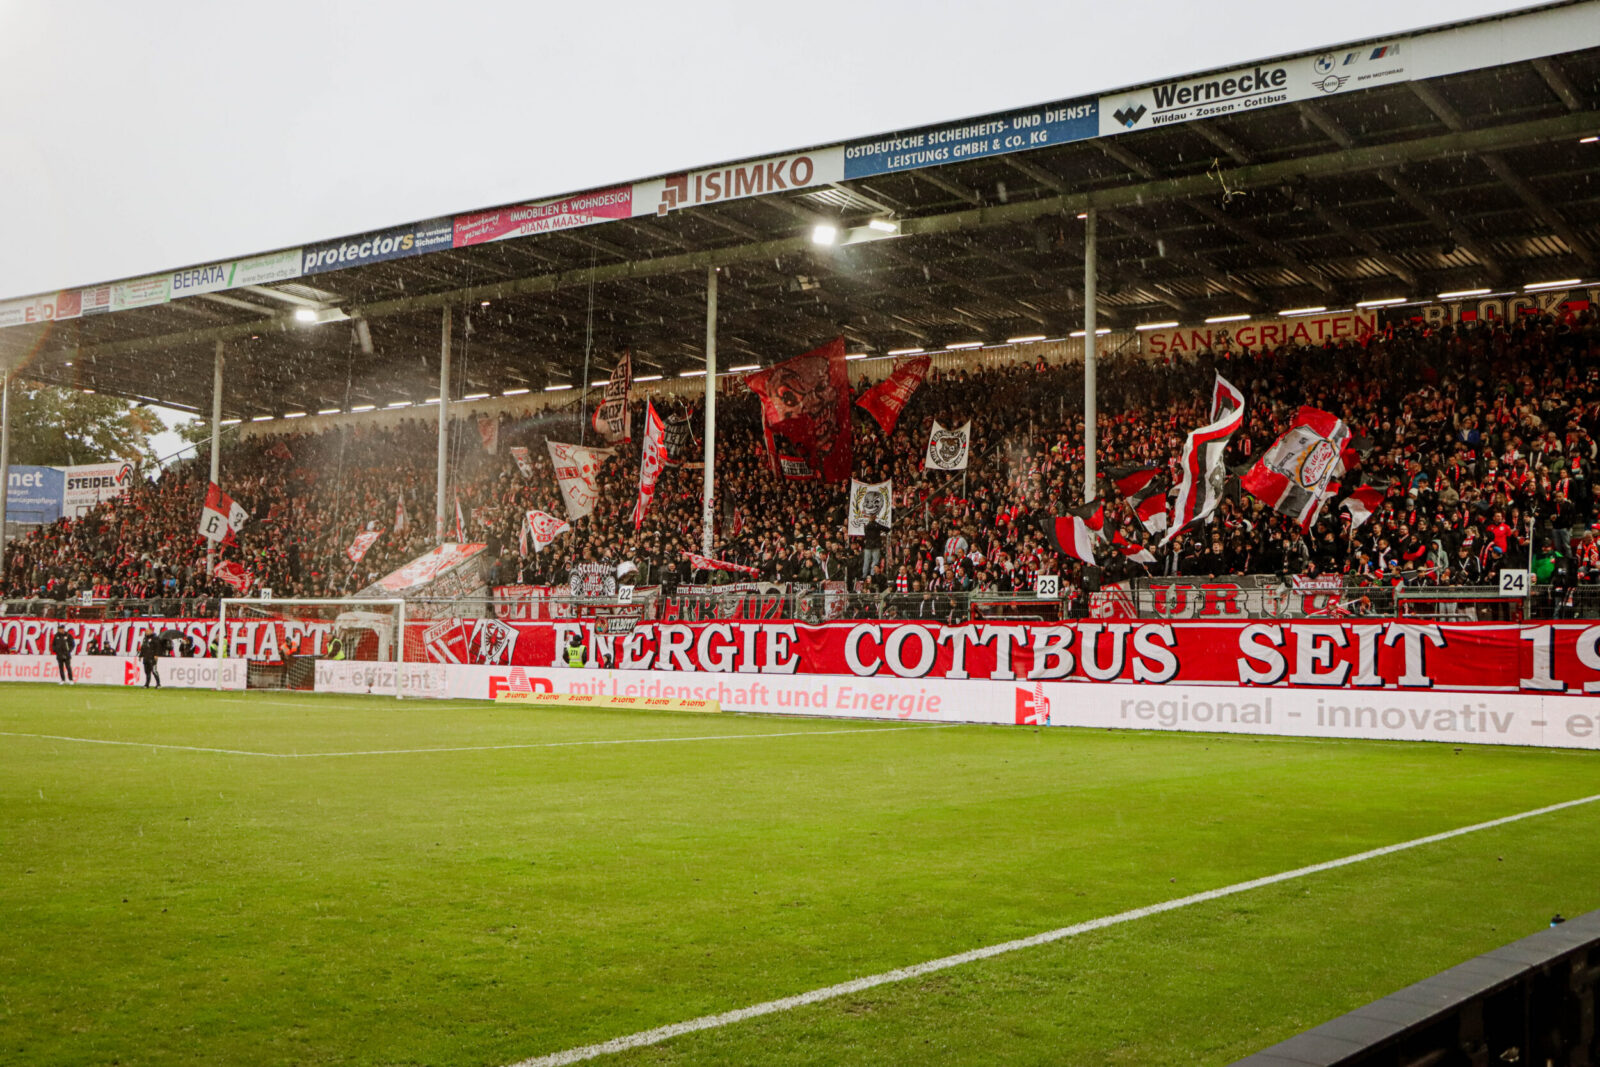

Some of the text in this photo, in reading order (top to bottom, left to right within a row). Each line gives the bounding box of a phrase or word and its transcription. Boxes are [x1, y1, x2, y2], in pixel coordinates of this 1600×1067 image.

[1153, 68, 1287, 109] Wernecke
[1152, 93, 1287, 125] Wildau Zossen Cottbus
[846, 104, 1096, 159] OSTDEUTSCHE SICHERHEITS- UND DIENST-
[887, 130, 1048, 169] LEISTUNGS GMBH & CO. KG
[695, 156, 813, 203] ISIMKO
[511, 191, 631, 222] IMMOBILIEN & WOHNDESIGN
[520, 212, 593, 234] DIANA MAASCH
[304, 233, 414, 272] protectors
[173, 265, 225, 290] BERATA
[1234, 314, 1376, 347] GRIATEN
[67, 476, 116, 490] STEIDEL
[619, 588, 632, 600] 22
[1039, 579, 1056, 594] 23
[1299, 581, 1336, 589] KEVIN
[1503, 573, 1525, 591] 24
[15, 661, 41, 678] und
[551, 621, 801, 675] ENERGIE
[844, 622, 1180, 684] COTTBUS
[1237, 621, 1448, 688] SEIT
[569, 677, 606, 695] mit
[612, 678, 769, 706] Leidenschaft
[777, 685, 828, 708] und
[836, 685, 942, 719] Energie
[1120, 694, 1272, 727] regional
[1316, 698, 1515, 734] innovativ
